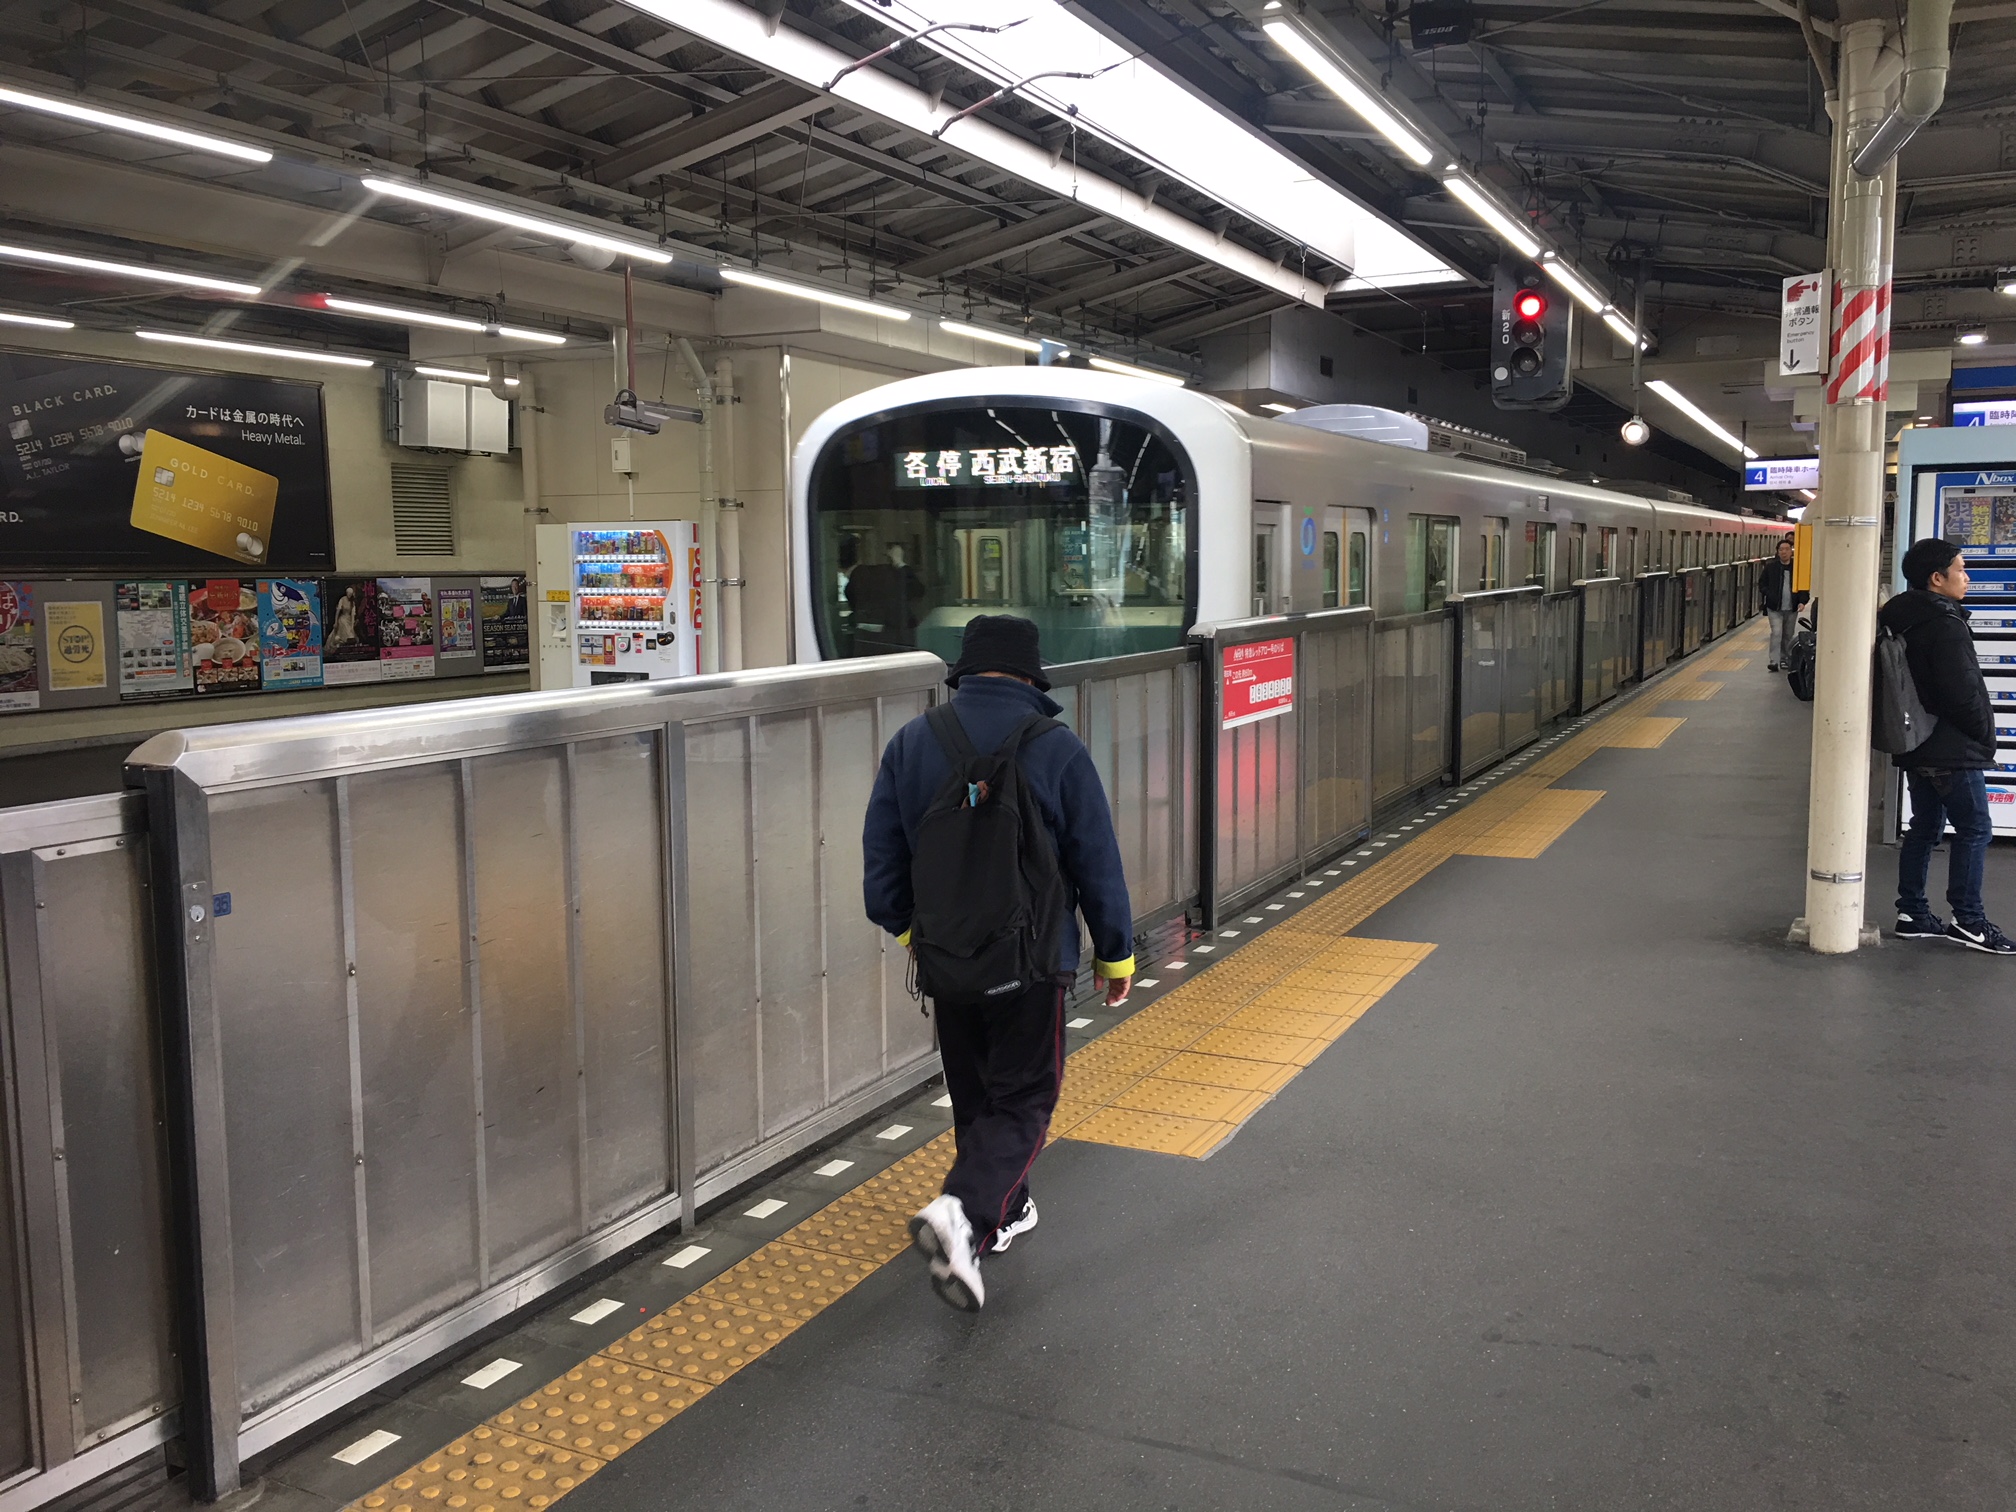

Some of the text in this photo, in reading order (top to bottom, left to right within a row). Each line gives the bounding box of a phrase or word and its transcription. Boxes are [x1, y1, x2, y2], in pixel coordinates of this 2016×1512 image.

[1785, 304, 1820, 318] 非常通報
[1788, 316, 1815, 327] ボタン
[1786, 330, 1815, 339] Emergency
[1786, 336, 1805, 344] button
[11, 394, 65, 416] BLACK
[185, 404, 305, 428] カードは金属の時代へ
[15, 439, 43, 456] 5214
[49, 431, 75, 448] 1234
[107, 417, 134, 432] 9010
[241, 429, 273, 445] Heavy
[969, 444, 1077, 476] 西武新宿
[169, 457, 208, 478] GOLD
[919, 477, 951, 487] LOCAL
[1754, 471, 1764, 483] 4
[1975, 472, 2014, 485] Nbox
[152, 486, 177, 503] 5214
[181, 497, 205, 512] 1234
[236, 516, 259, 532] 9010
[483, 624, 504, 632] SEASON
